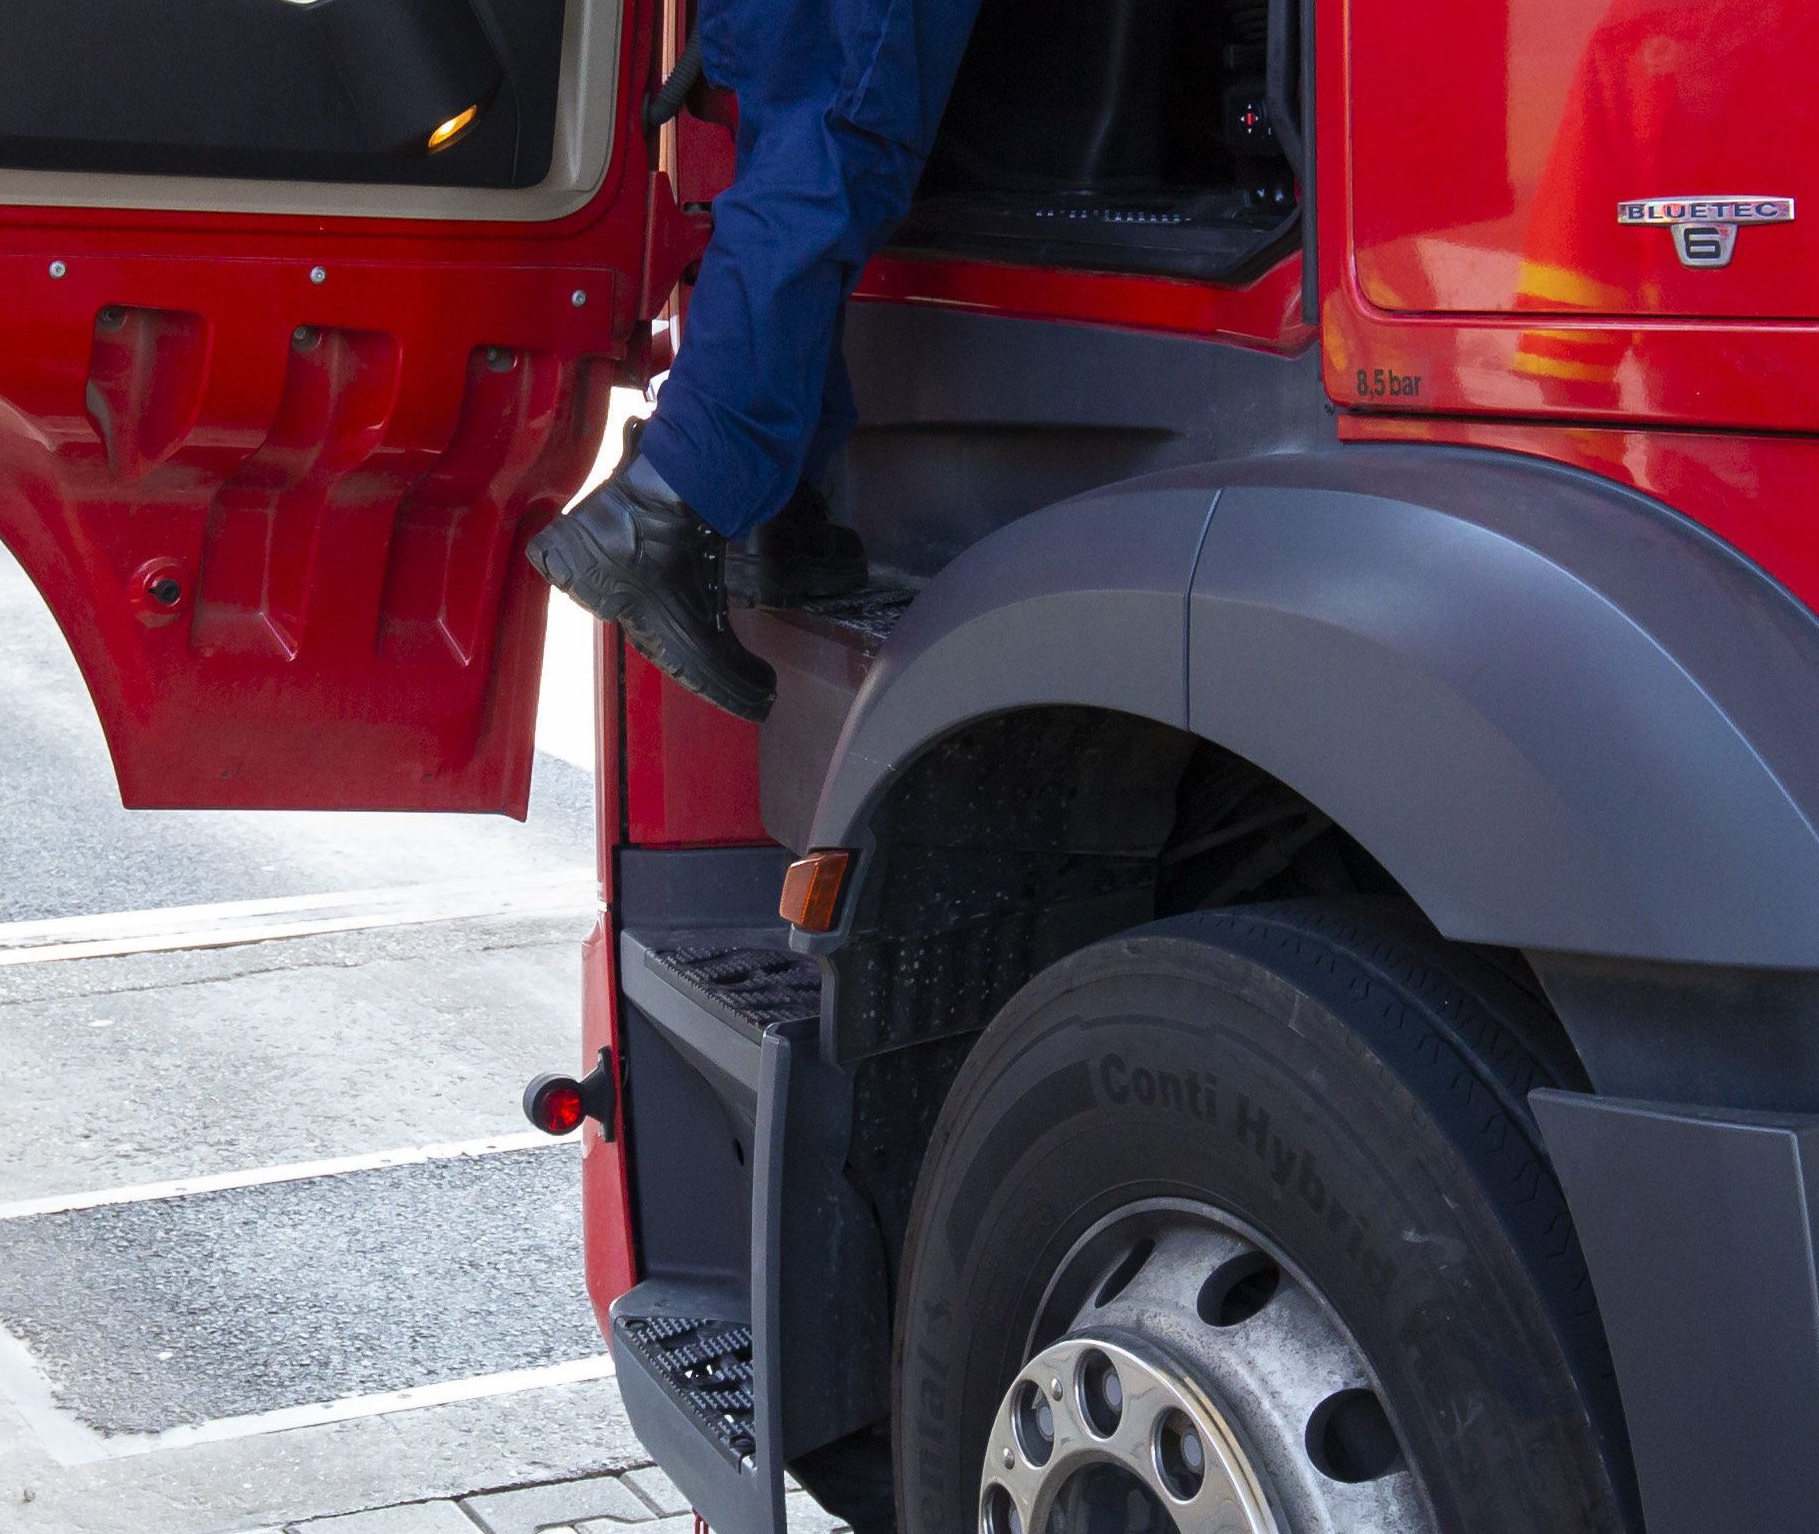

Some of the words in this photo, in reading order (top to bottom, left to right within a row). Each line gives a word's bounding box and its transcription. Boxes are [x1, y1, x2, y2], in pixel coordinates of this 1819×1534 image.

[1627, 201, 1779, 220] BLUETEC
[1684, 227, 1722, 259] 6
[1356, 369, 1385, 398] 8,5
[1388, 369, 1422, 397] bar
[1100, 1052, 1218, 1124] Conti
